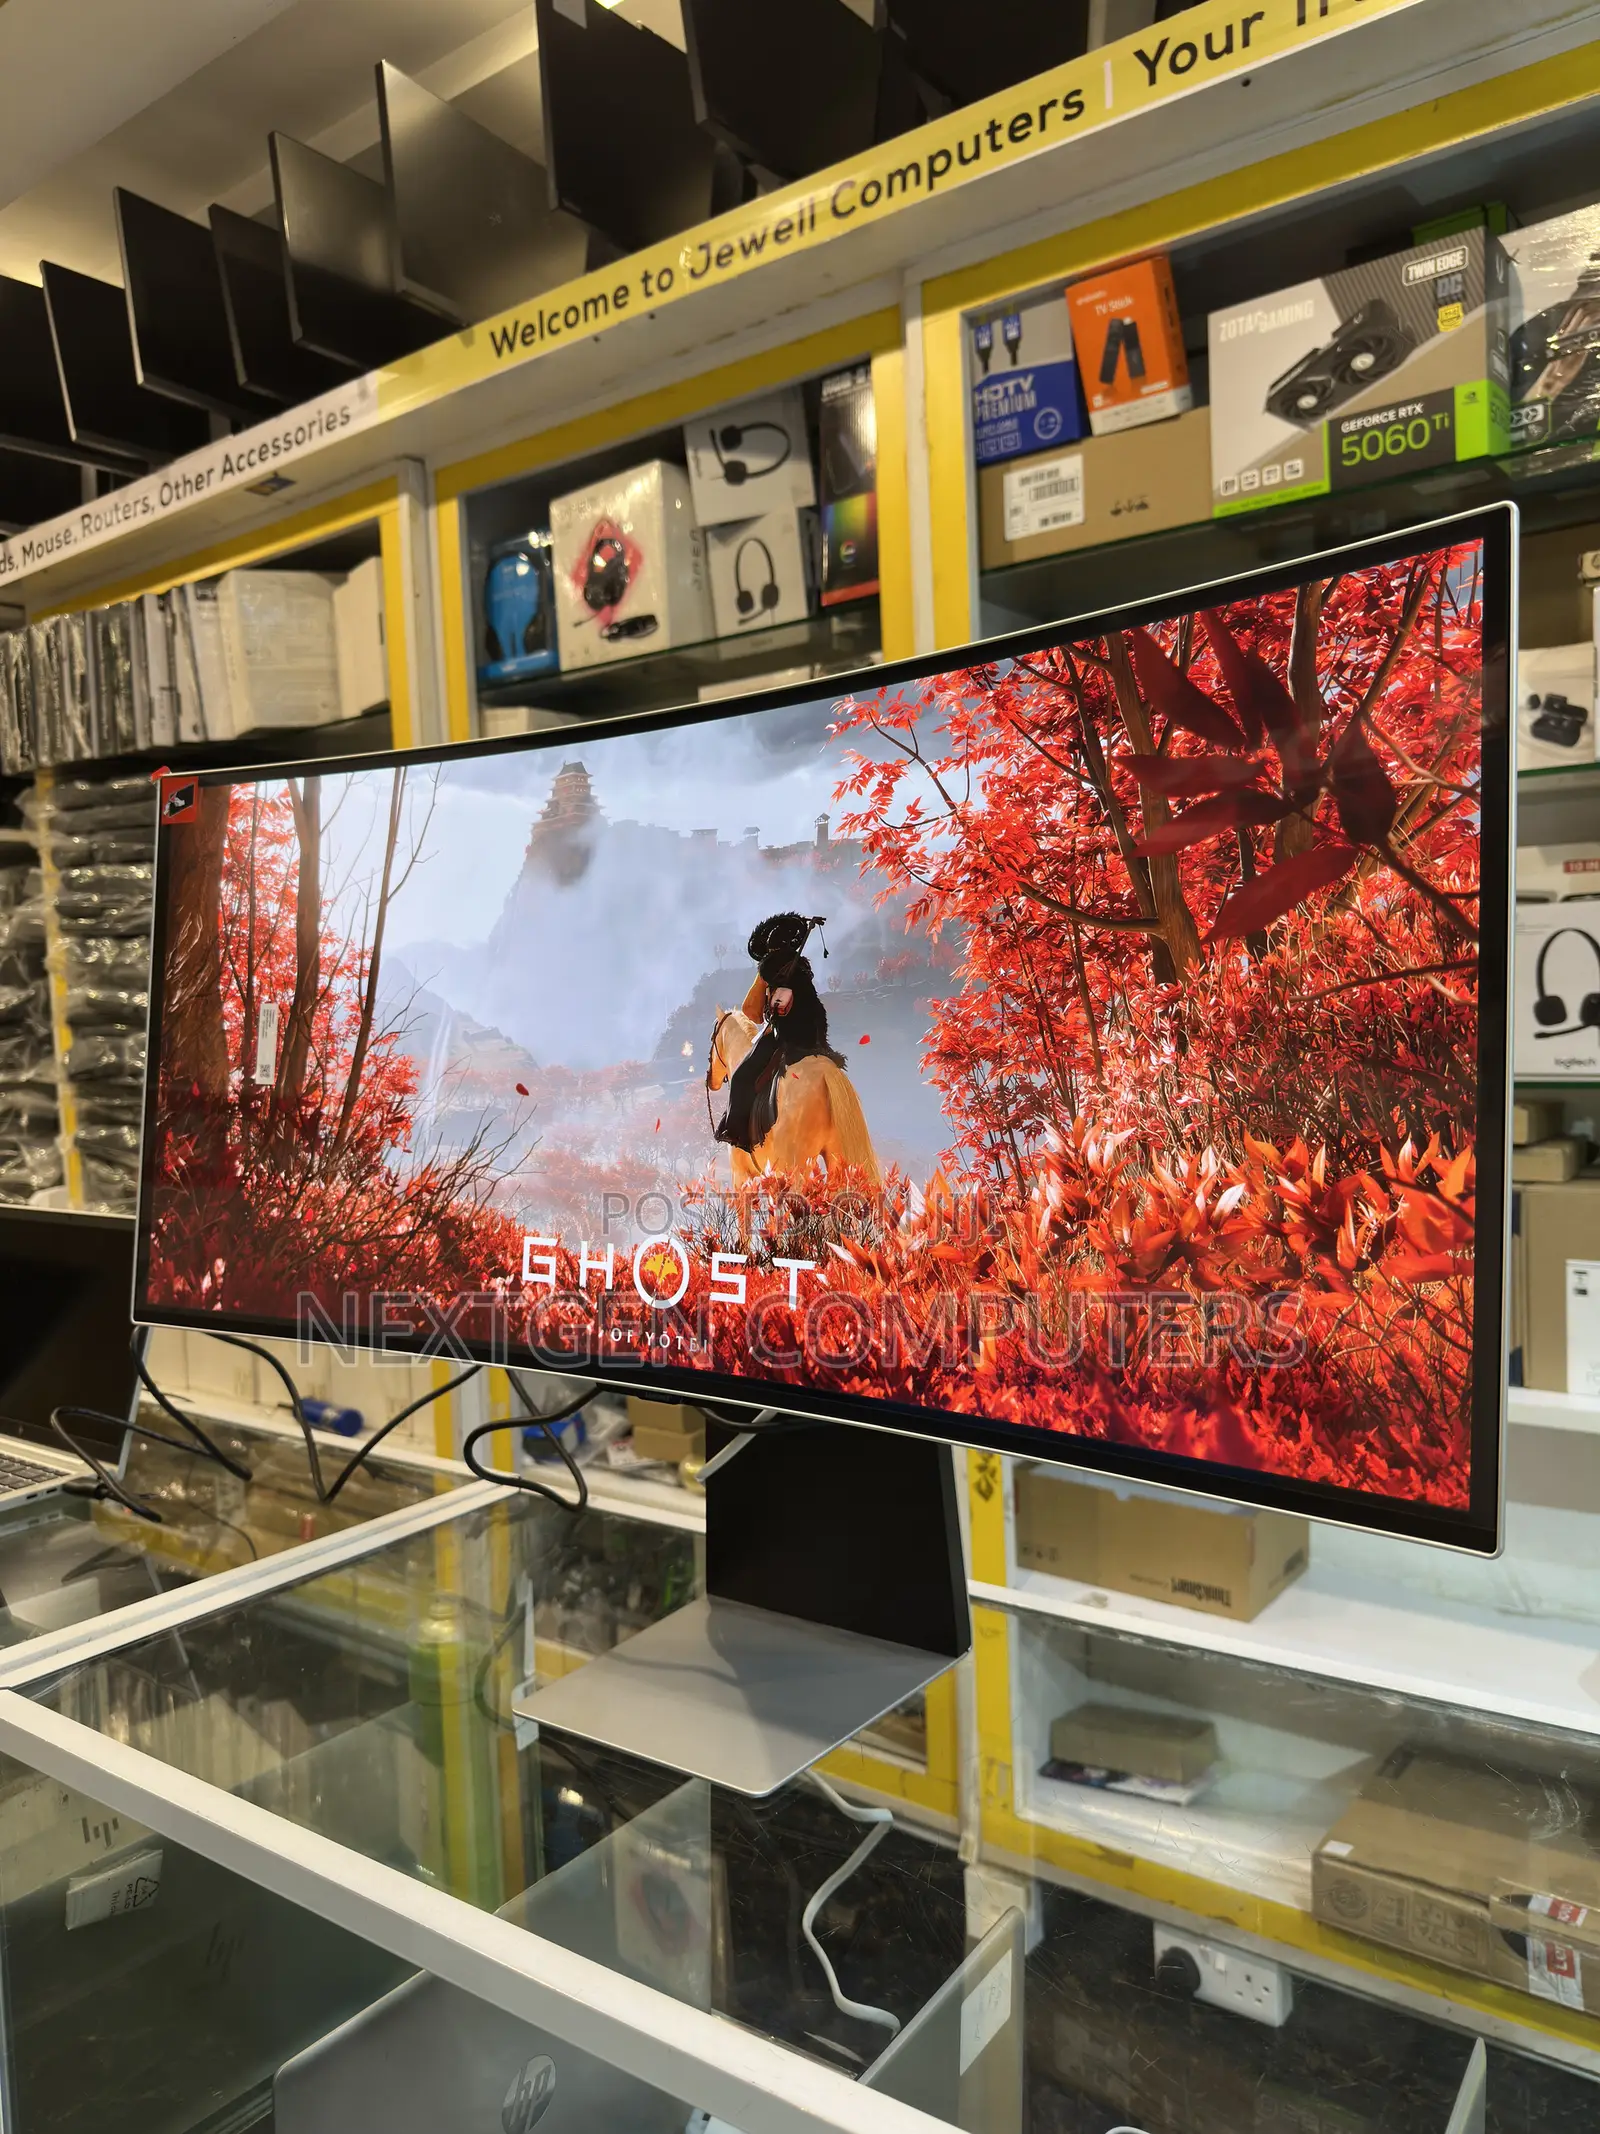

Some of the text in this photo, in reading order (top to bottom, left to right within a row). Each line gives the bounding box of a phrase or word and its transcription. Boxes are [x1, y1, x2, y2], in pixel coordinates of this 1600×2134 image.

[489, 284, 629, 358] Welcome
[641, 268, 674, 298] to
[689, 196, 816, 279] Jewell
[831, 89, 1085, 219] Computers
[1133, 11, 1265, 87] Your
[1407, 250, 1464, 281] TWIN EDGE
[1260, 299, 1314, 334] GAMING
[1341, 402, 1425, 434] GEFORCE RTX
[1342, 412, 1449, 466] 5060 Ti
[22, 524, 78, 568] Mouse,
[81, 494, 156, 539] Routers,
[160, 466, 214, 506] Other
[220, 404, 350, 481] Accessories
[1554, 1056, 1597, 1068] logitech
[522, 1234, 816, 1311] GHOST
[611, 1327, 634, 1342] OF
[1171, 1577, 1232, 1608] ThinkSmart
